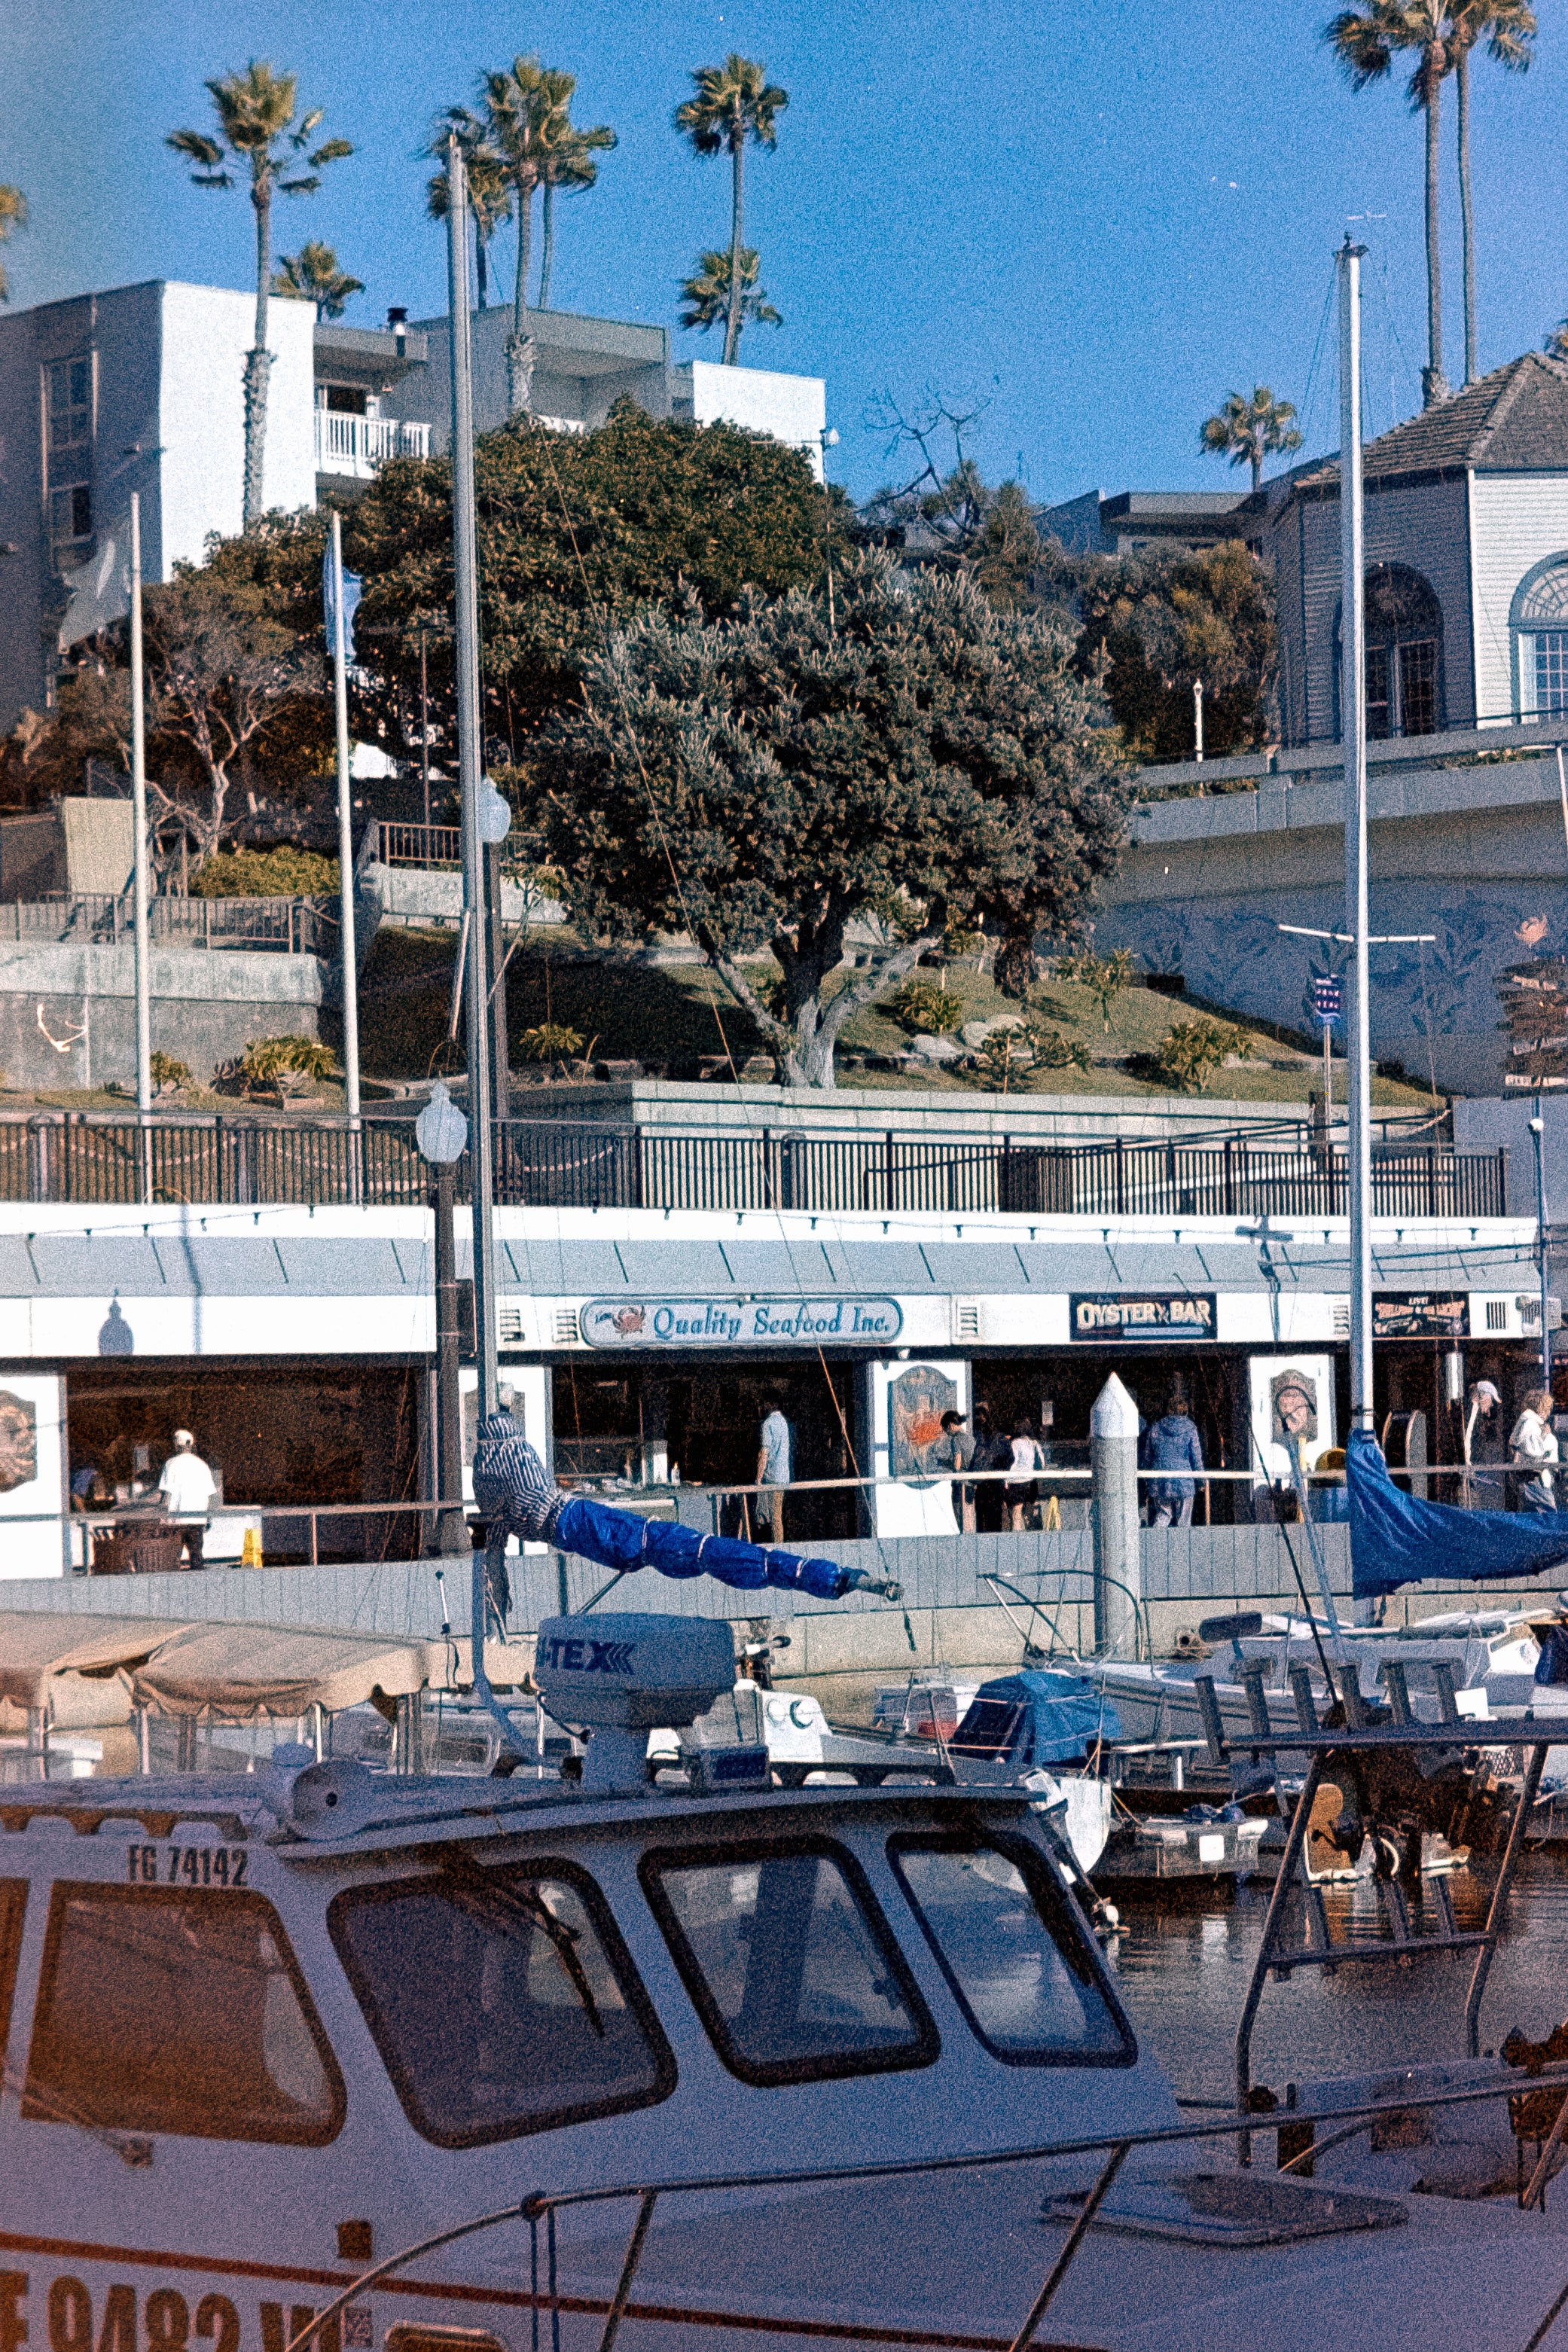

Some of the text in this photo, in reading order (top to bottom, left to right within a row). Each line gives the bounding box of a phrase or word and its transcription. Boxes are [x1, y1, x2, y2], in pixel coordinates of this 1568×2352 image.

[653, 1301, 889, 1341] Quality Seafood Inc.
[1077, 1300, 1212, 1330] OYSTER BAR
[129, 1844, 248, 1886] FG 74142
